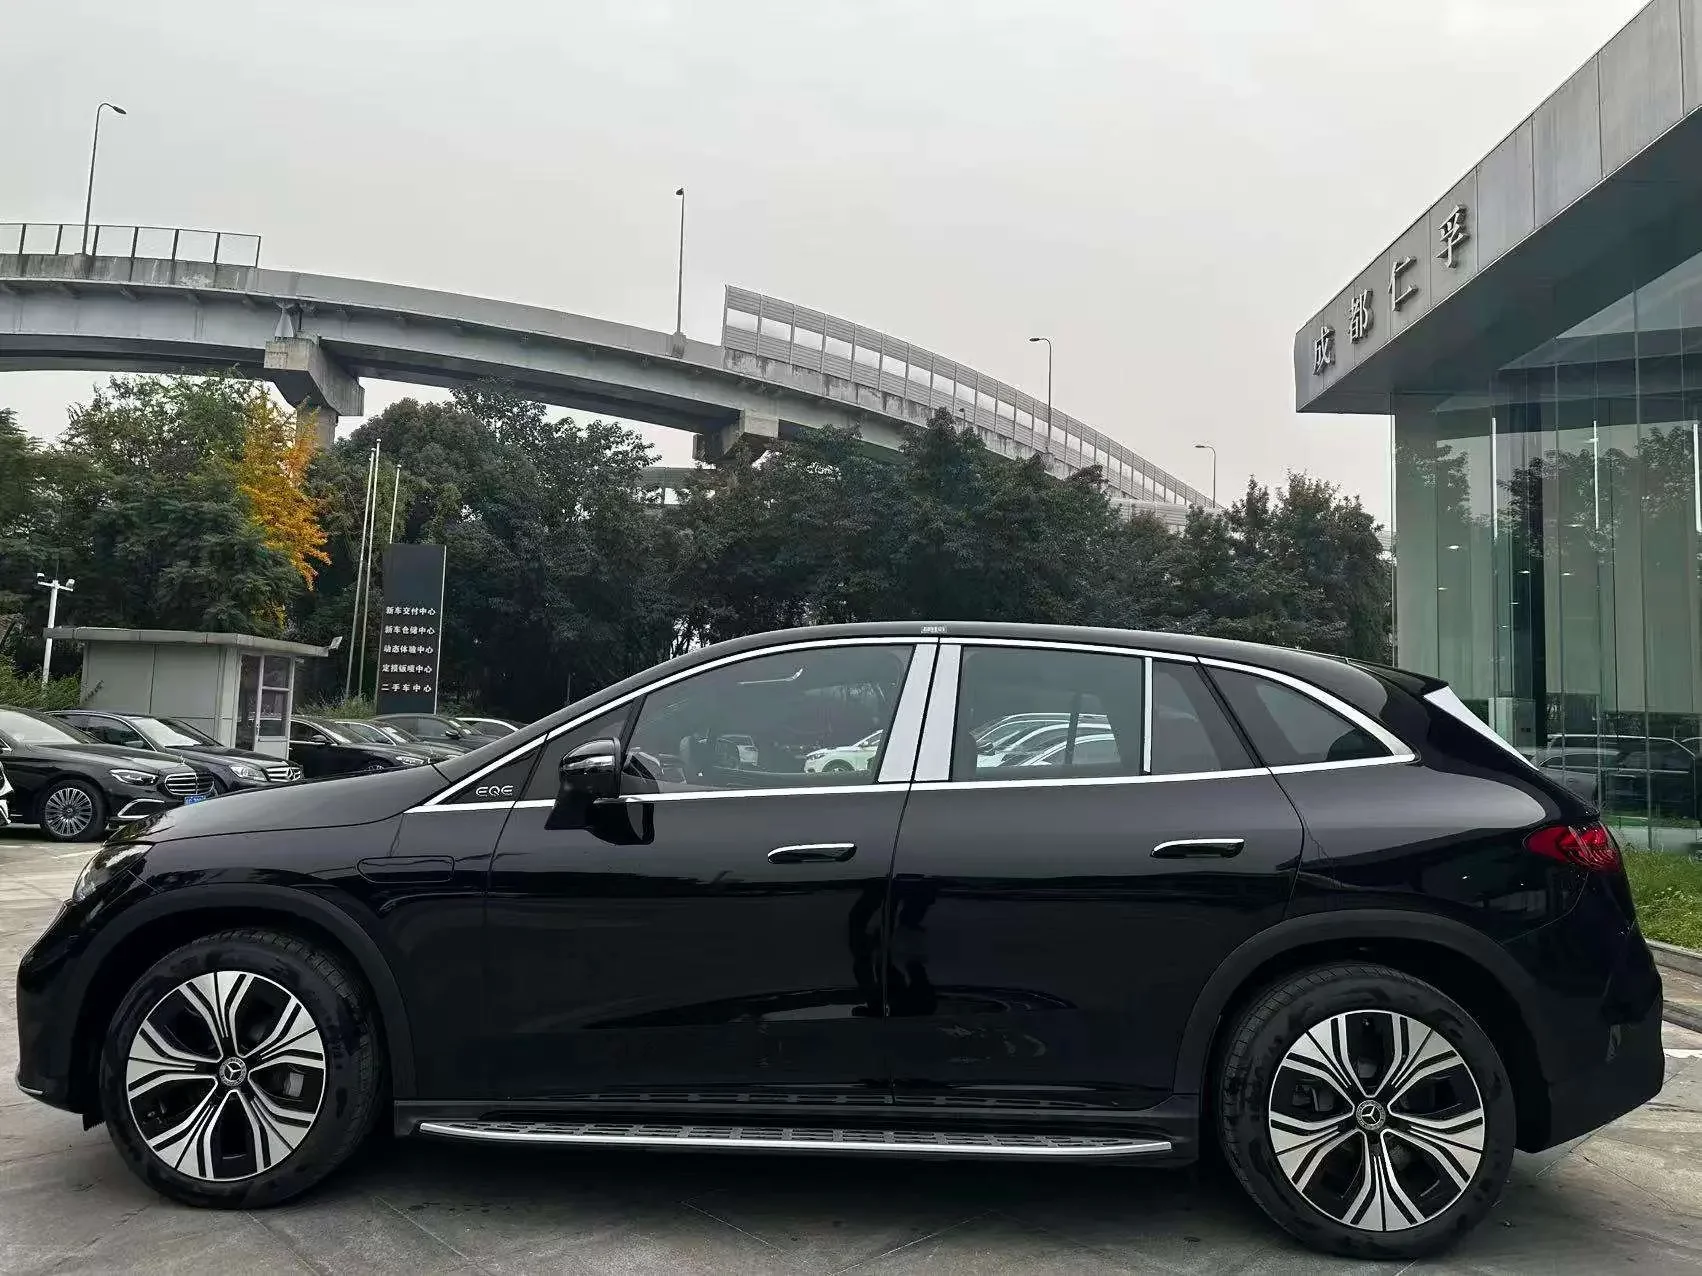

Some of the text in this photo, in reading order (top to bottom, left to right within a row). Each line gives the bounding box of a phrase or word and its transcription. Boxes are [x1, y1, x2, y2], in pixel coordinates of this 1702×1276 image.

[1313, 204, 1471, 376] 成都仁孚
[385, 606, 436, 616] 新车交付中心
[384, 625, 435, 635] 新车仓储中心
[383, 644, 434, 654] 动态体验中心
[381, 683, 432, 693] 二手车中心
[475, 785, 514, 797] EQE
